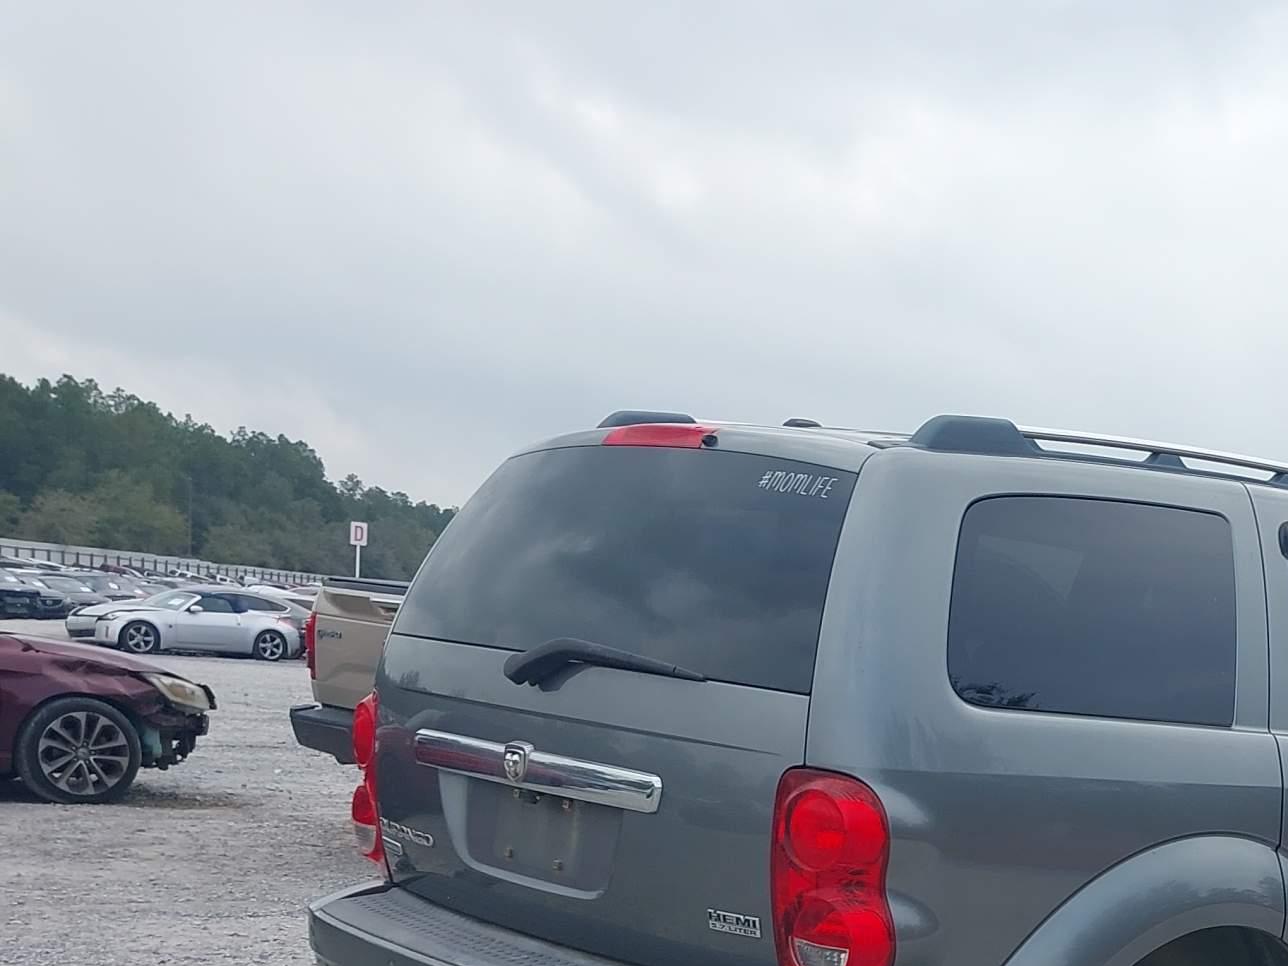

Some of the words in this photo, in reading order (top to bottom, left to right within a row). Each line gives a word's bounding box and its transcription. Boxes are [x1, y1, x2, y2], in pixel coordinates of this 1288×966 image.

[758, 470, 839, 499] #MOMLIFE
[354, 525, 364, 542] D
[708, 909, 758, 930] HEMI
